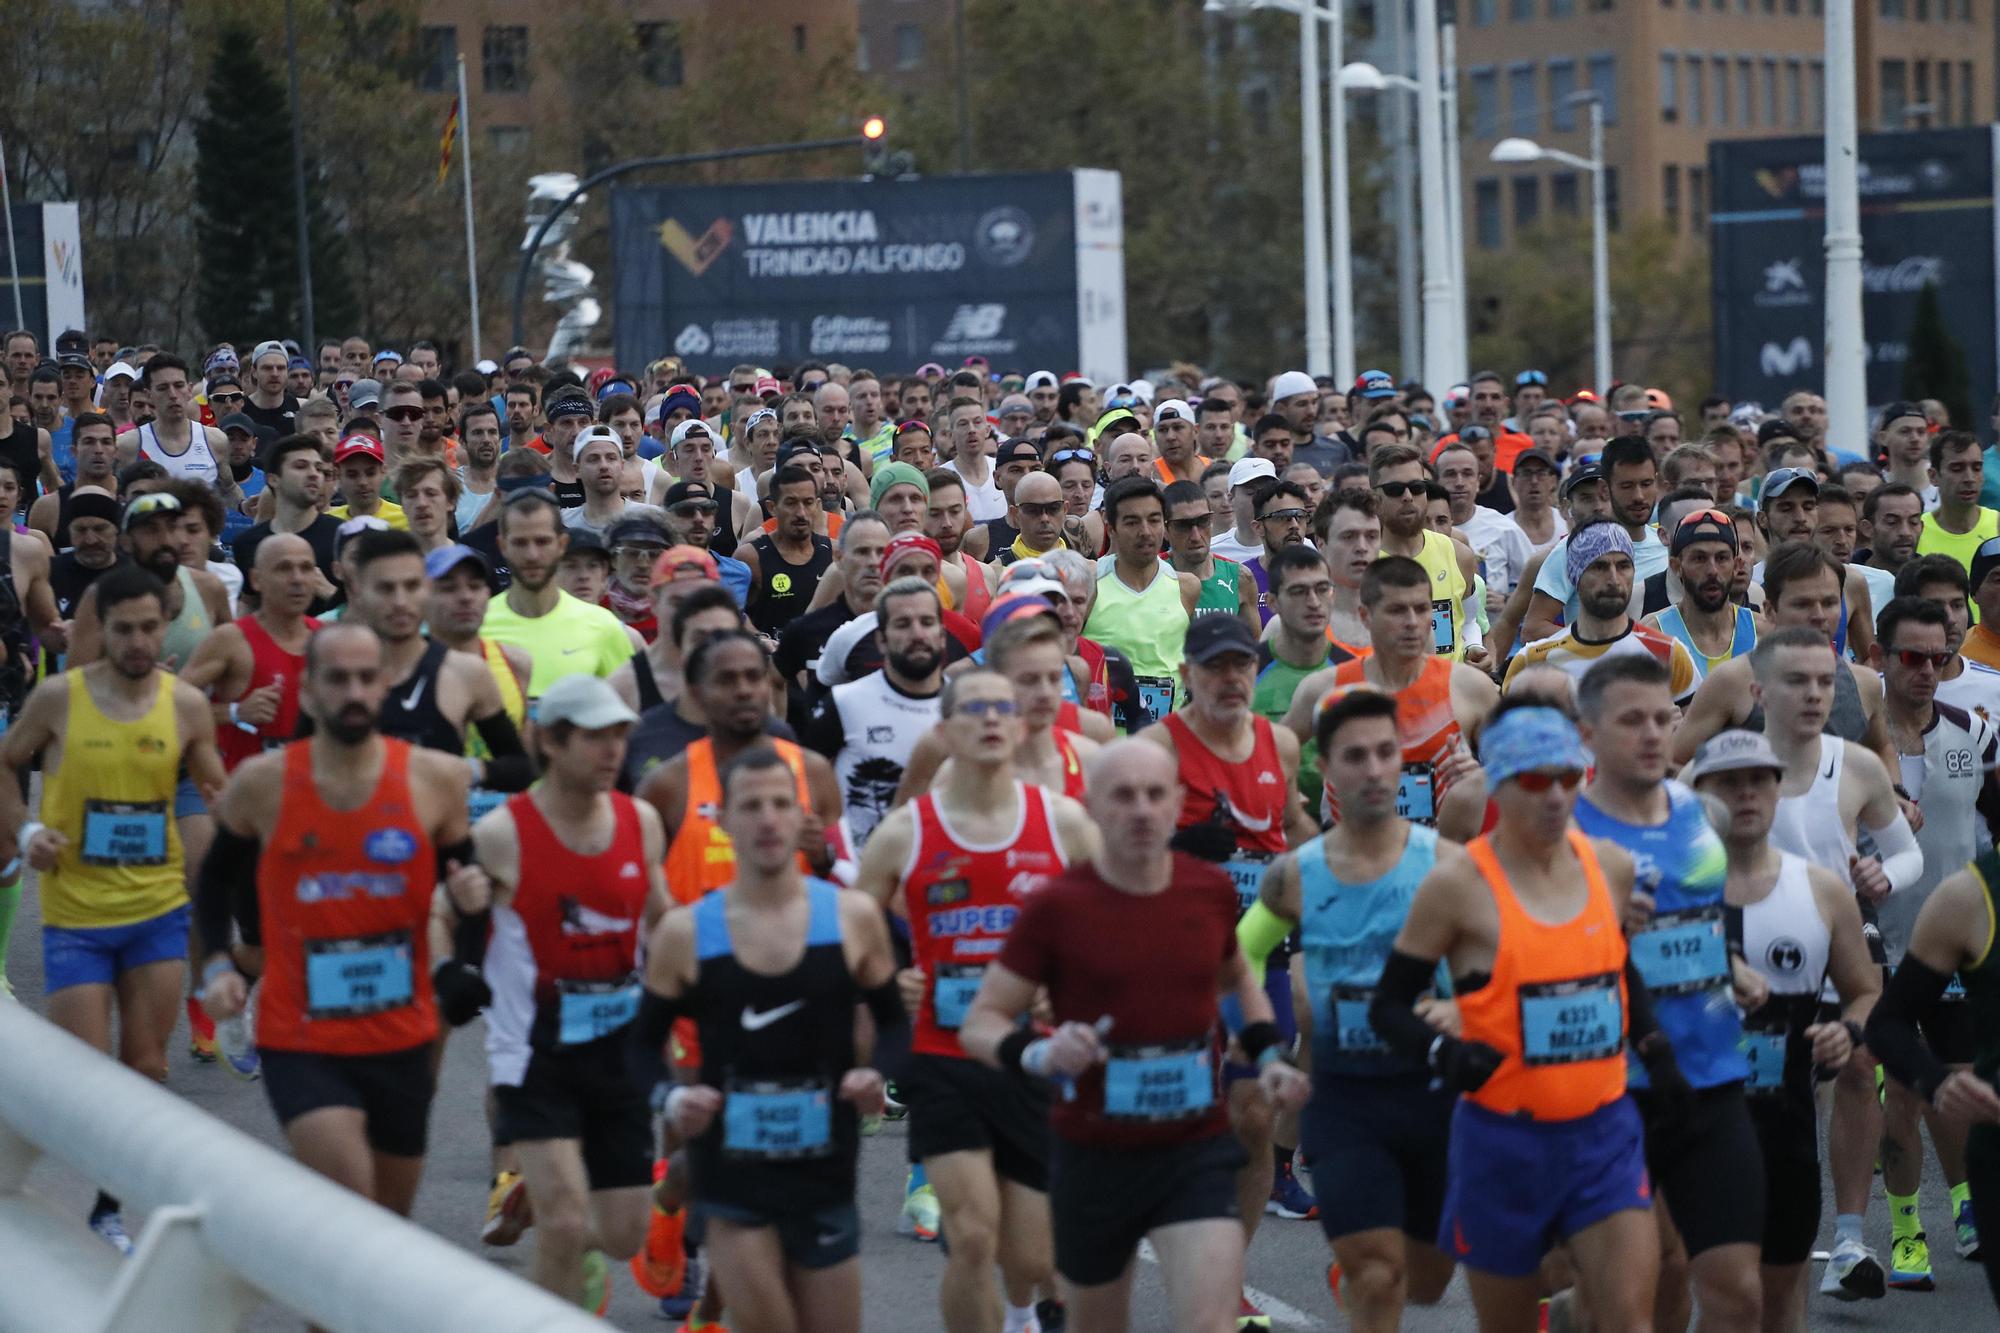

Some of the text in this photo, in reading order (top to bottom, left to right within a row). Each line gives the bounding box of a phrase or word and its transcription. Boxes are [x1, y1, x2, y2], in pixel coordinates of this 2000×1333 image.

[743, 210, 878, 244] VALENCIA
[743, 242, 966, 277] TRINIDAD ALFONSO
[1946, 749, 1973, 773] 82
